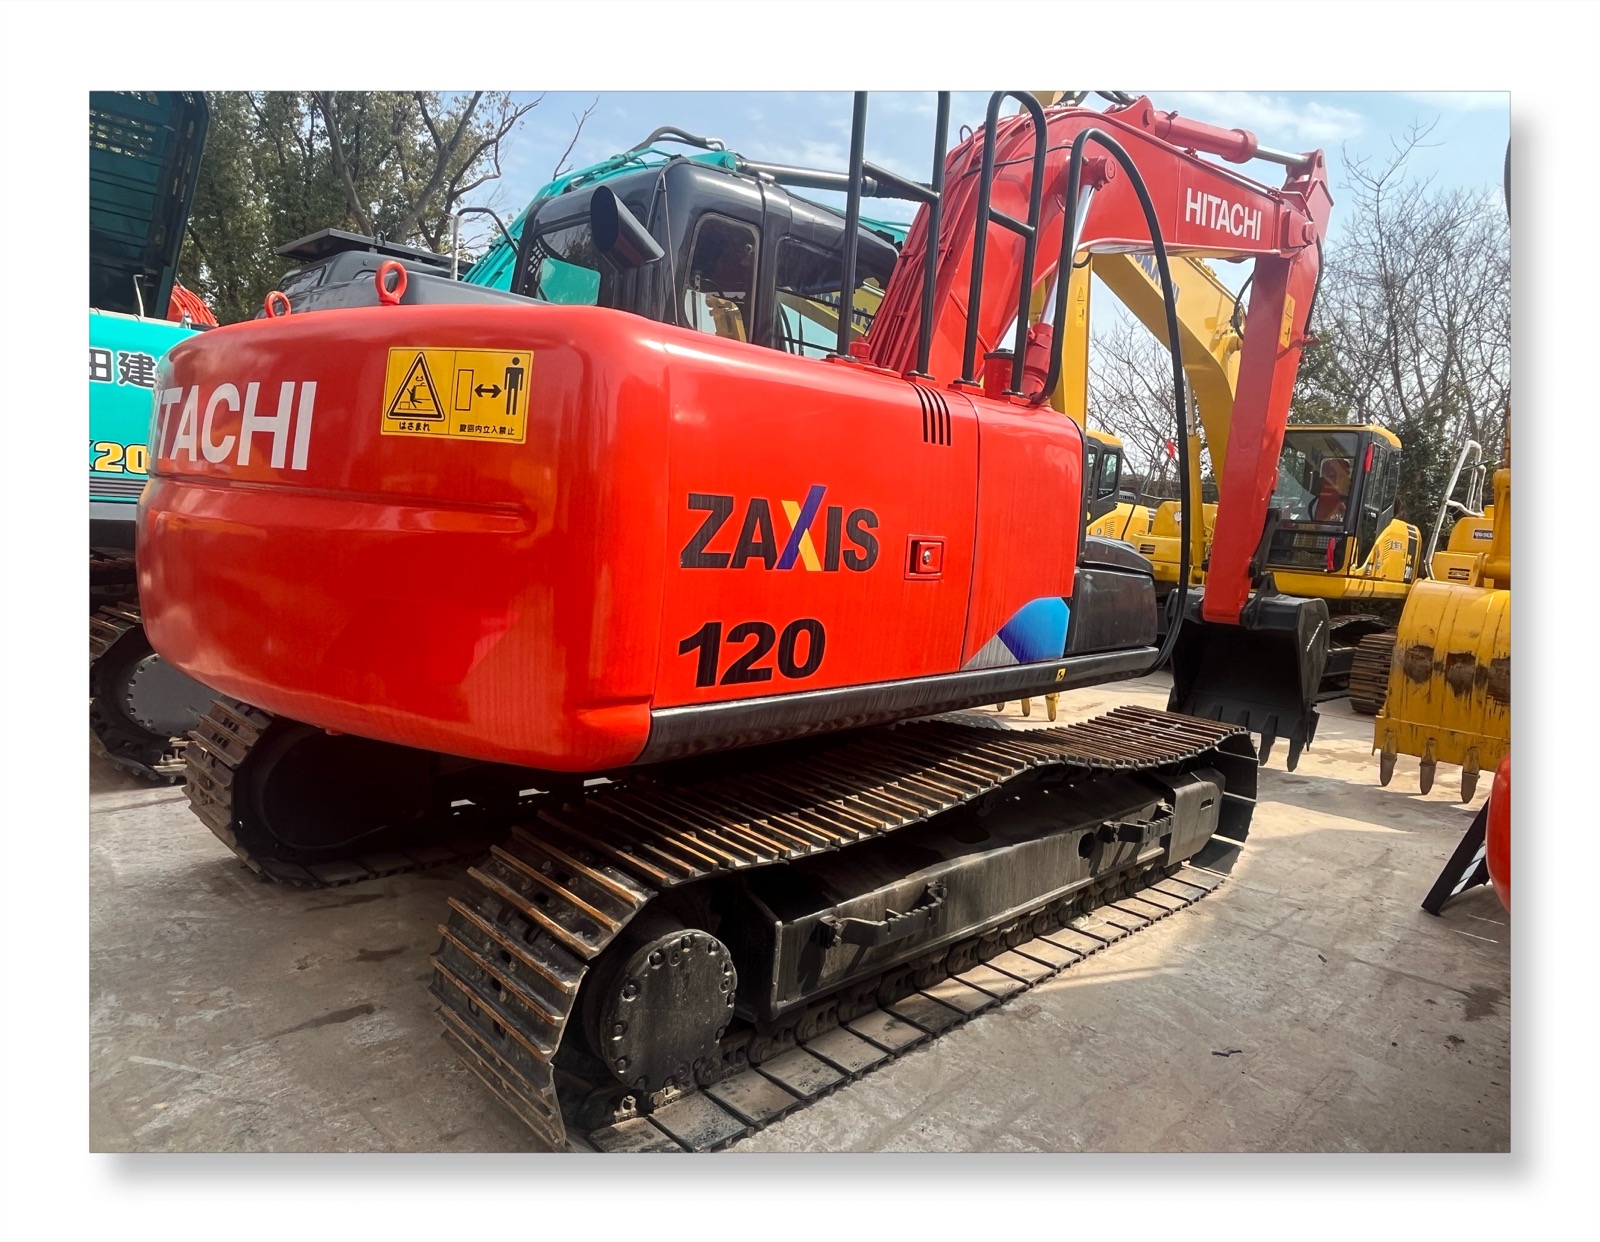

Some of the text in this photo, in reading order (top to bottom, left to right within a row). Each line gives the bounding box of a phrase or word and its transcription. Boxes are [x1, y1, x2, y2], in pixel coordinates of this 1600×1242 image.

[1185, 187, 1262, 241] HITACHI
[399, 421, 430, 431] はさまれ
[89, 440, 149, 475] 20
[680, 484, 879, 572] ZAXIS
[678, 618, 826, 688] 120
